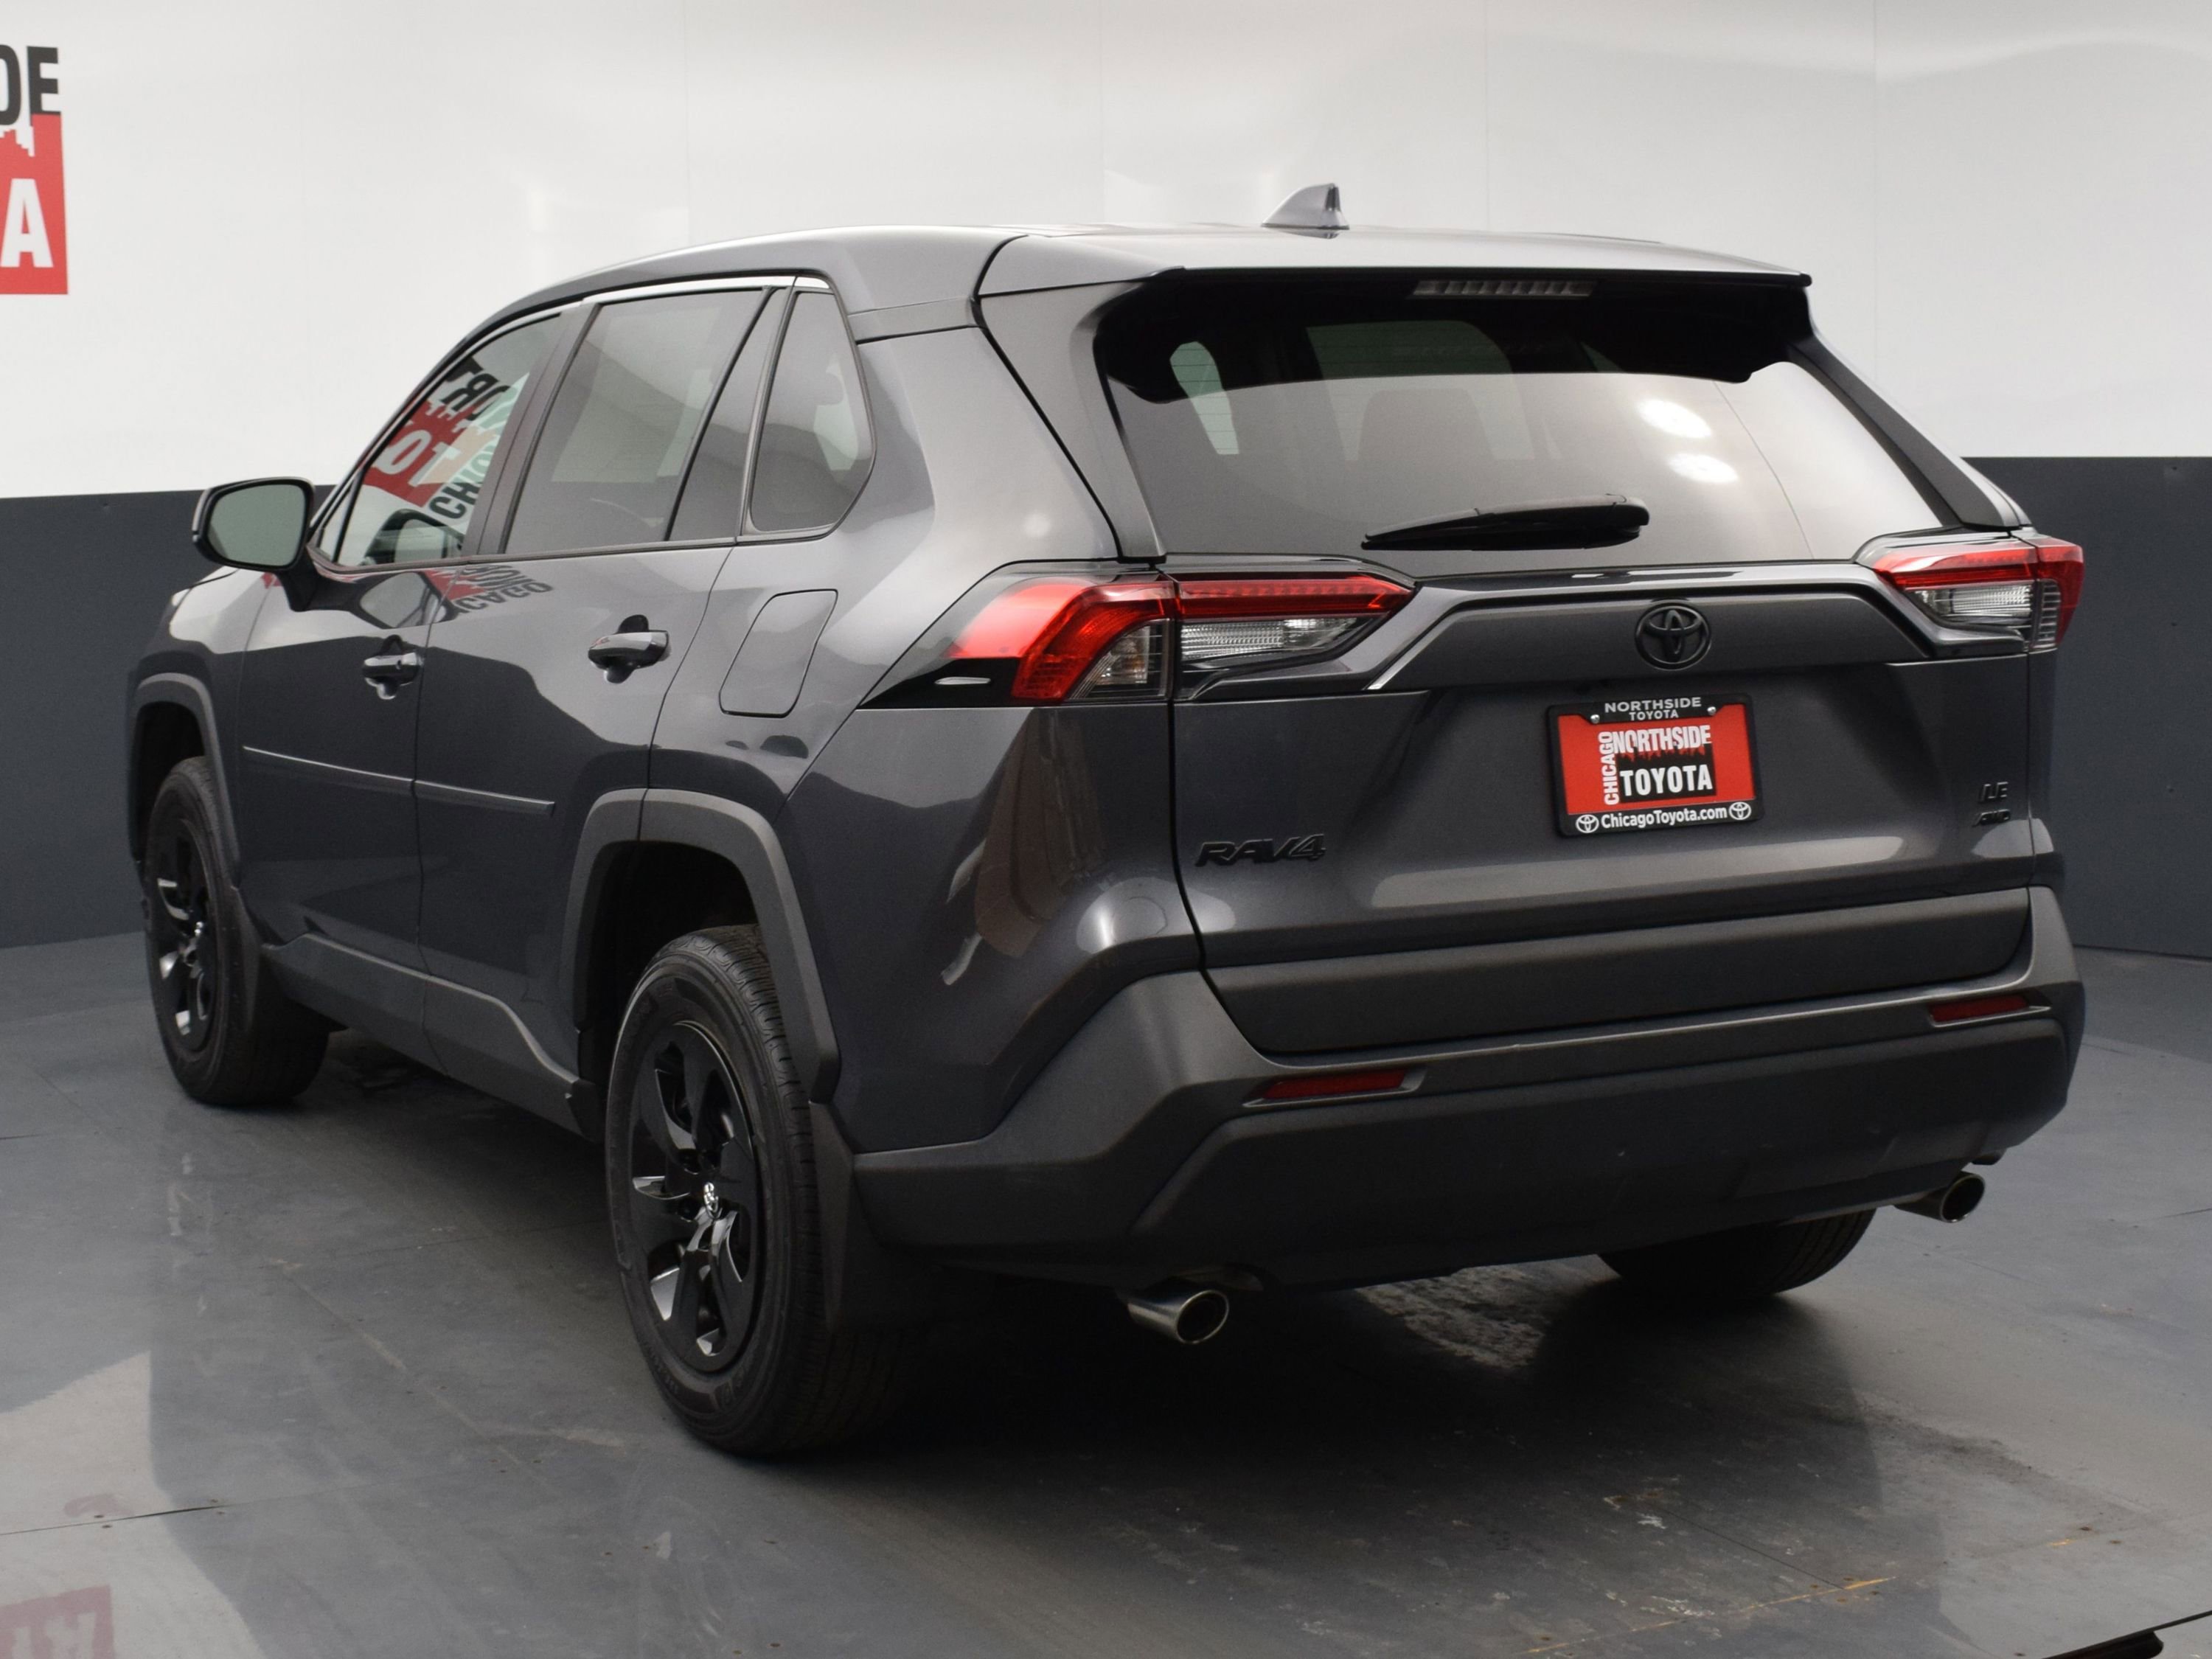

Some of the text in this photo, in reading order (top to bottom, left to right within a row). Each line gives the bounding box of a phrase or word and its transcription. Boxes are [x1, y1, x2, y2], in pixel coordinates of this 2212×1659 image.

[1604, 697, 1702, 714] NORTHSIDE
[1629, 709, 1680, 721] TOYOTA
[1612, 724, 1713, 754] NORTHSIDE
[1598, 731, 1620, 806] CHICAGO
[1619, 763, 1714, 797] TOYOTA
[1978, 781, 2009, 804] LE
[1600, 805, 1728, 830] ChicagoToyota.com
[1194, 833, 1326, 867] RAV4
